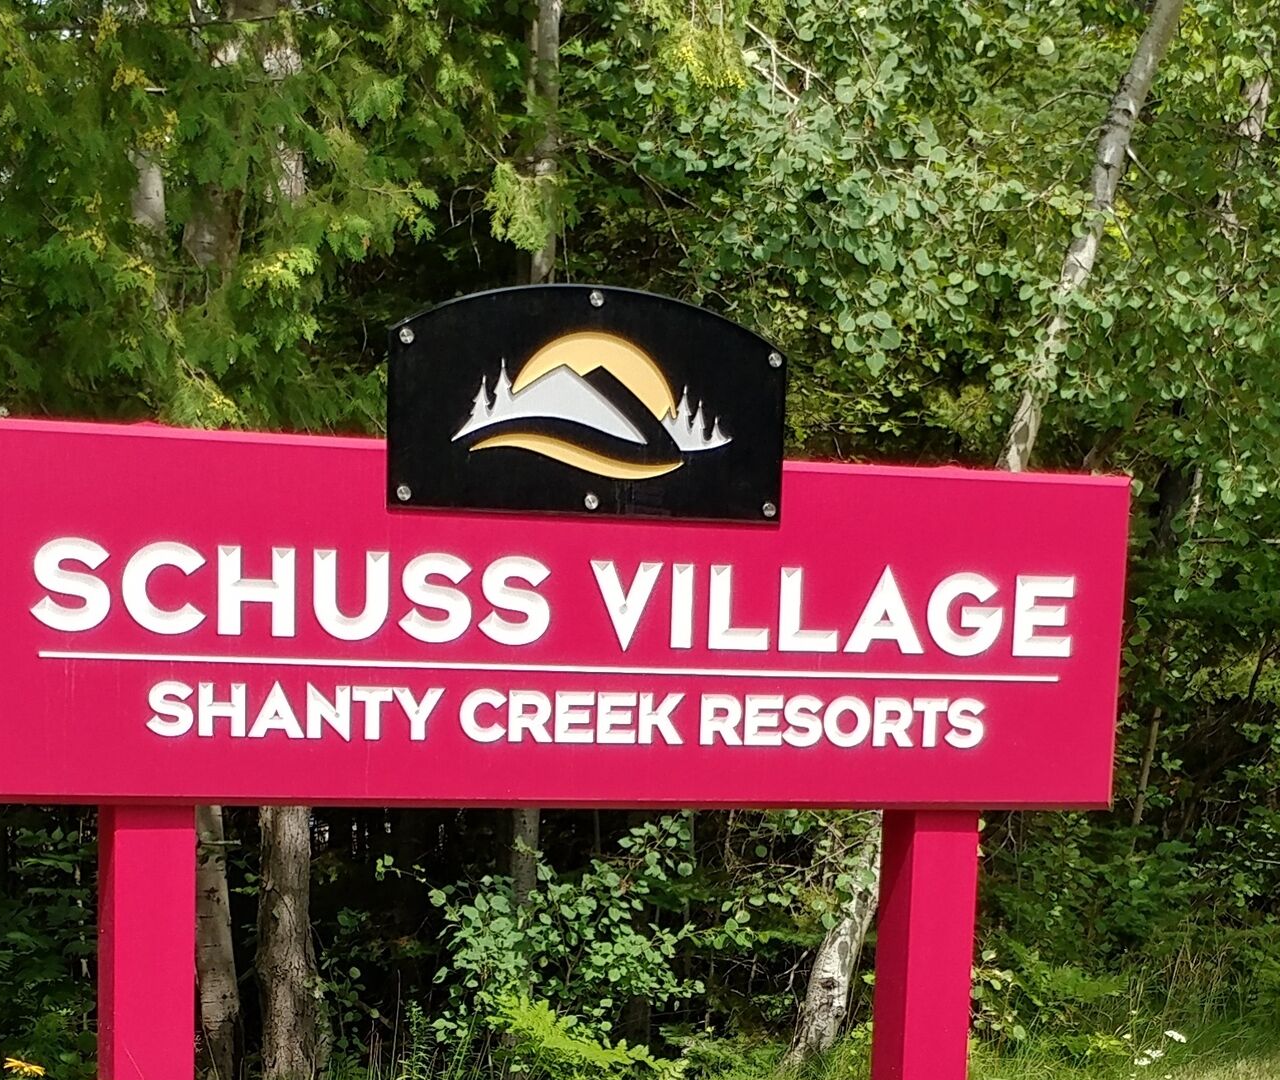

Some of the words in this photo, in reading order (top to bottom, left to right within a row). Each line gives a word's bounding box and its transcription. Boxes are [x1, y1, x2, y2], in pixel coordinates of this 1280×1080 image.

[30, 537, 552, 646] SCHUSS
[590, 560, 1076, 658] VILLAGE
[146, 681, 445, 742] SHANTY
[460, 688, 685, 745] CREEK
[699, 694, 986, 749] RESORTS
